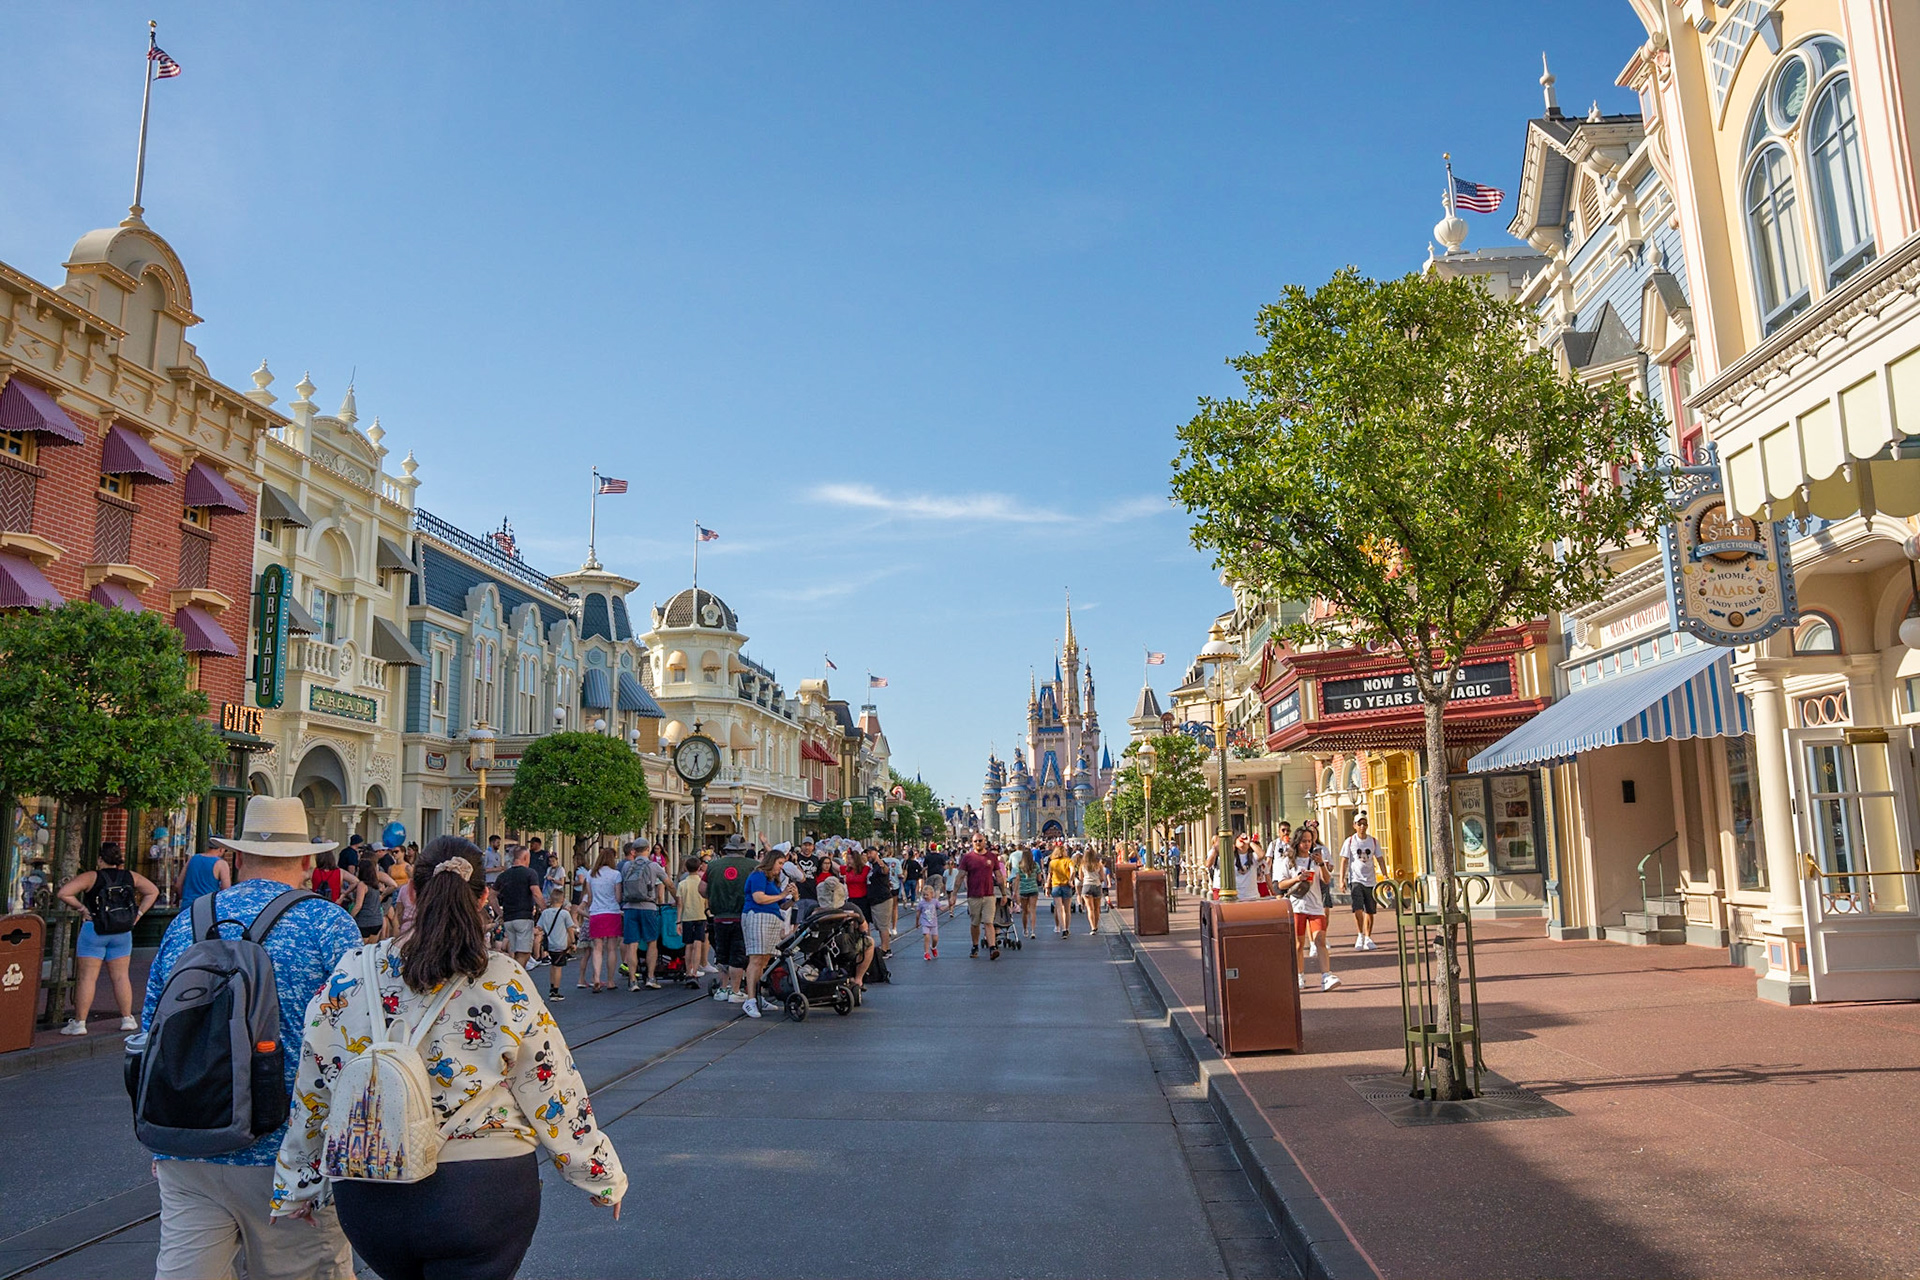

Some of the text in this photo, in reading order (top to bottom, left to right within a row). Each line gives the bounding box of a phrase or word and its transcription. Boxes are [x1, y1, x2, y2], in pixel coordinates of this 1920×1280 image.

[1708, 524, 1751, 541] STRET
[1699, 541, 1762, 553] CONFECTIONERY
[1717, 572, 1746, 581] HOME
[1705, 595, 1762, 608] CANDY TREATS
[261, 576, 277, 696] ARCADE
[1363, 677, 1394, 692] NOW
[316, 692, 370, 715] ARCADE
[1343, 697, 1362, 710] 50
[1366, 692, 1413, 708] YEARS
[224, 703, 265, 735] GIFTS
